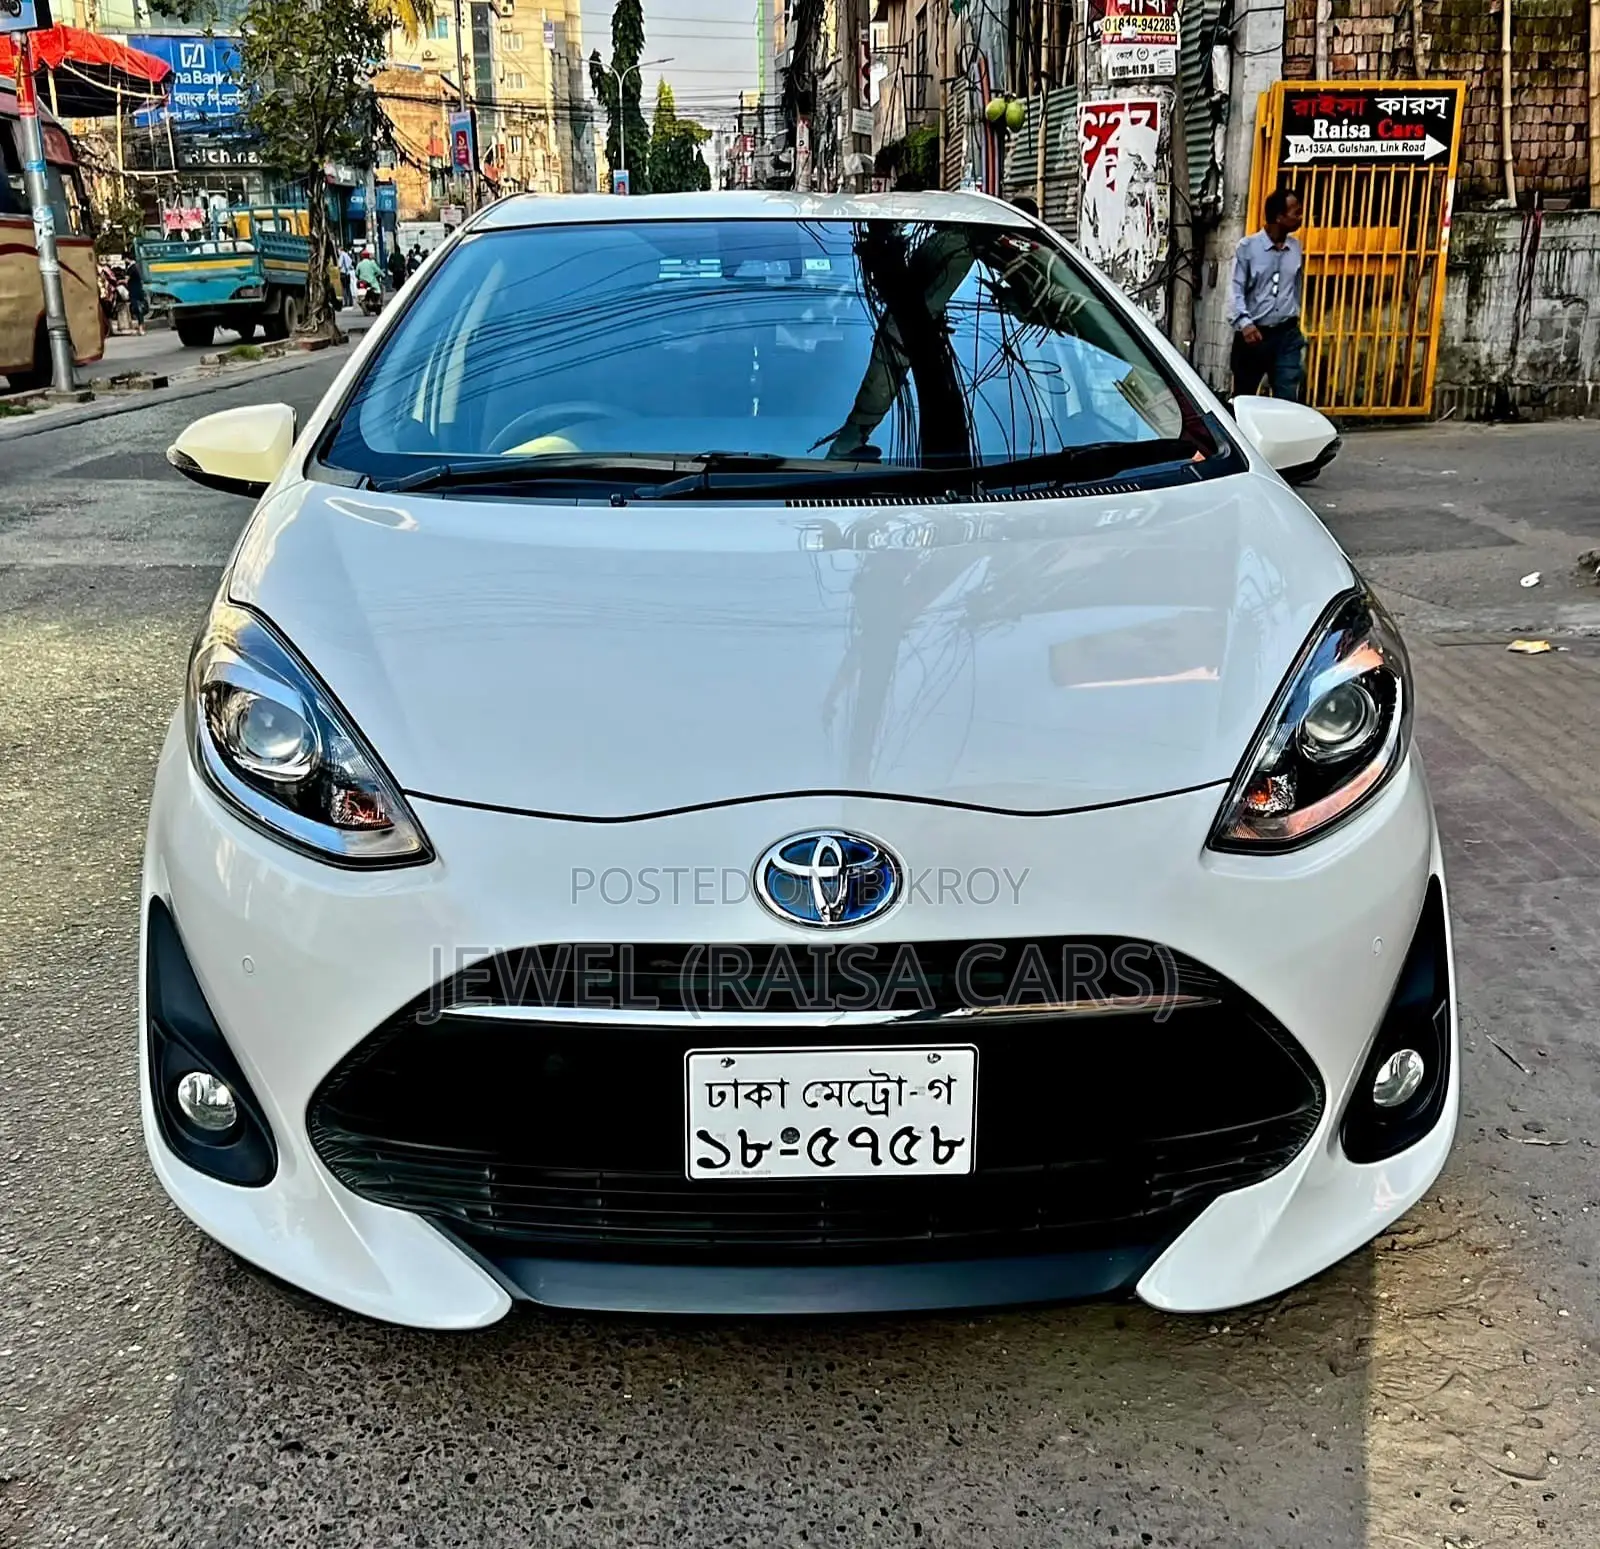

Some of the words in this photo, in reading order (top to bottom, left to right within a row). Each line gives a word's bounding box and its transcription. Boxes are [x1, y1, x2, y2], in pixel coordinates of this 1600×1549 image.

[193, 70, 224, 84] Bank
[1292, 93, 1367, 117] রাইসা
[1374, 95, 1449, 119] কারস্
[1313, 118, 1371, 139] Raisa
[1378, 118, 1425, 139] Cars
[1381, 142, 1400, 152] Link
[1402, 141, 1425, 152] Road
[705, 1078, 790, 1109] ঢাকা
[696, 1125, 965, 1169] ১৮-৫৭৫৮
